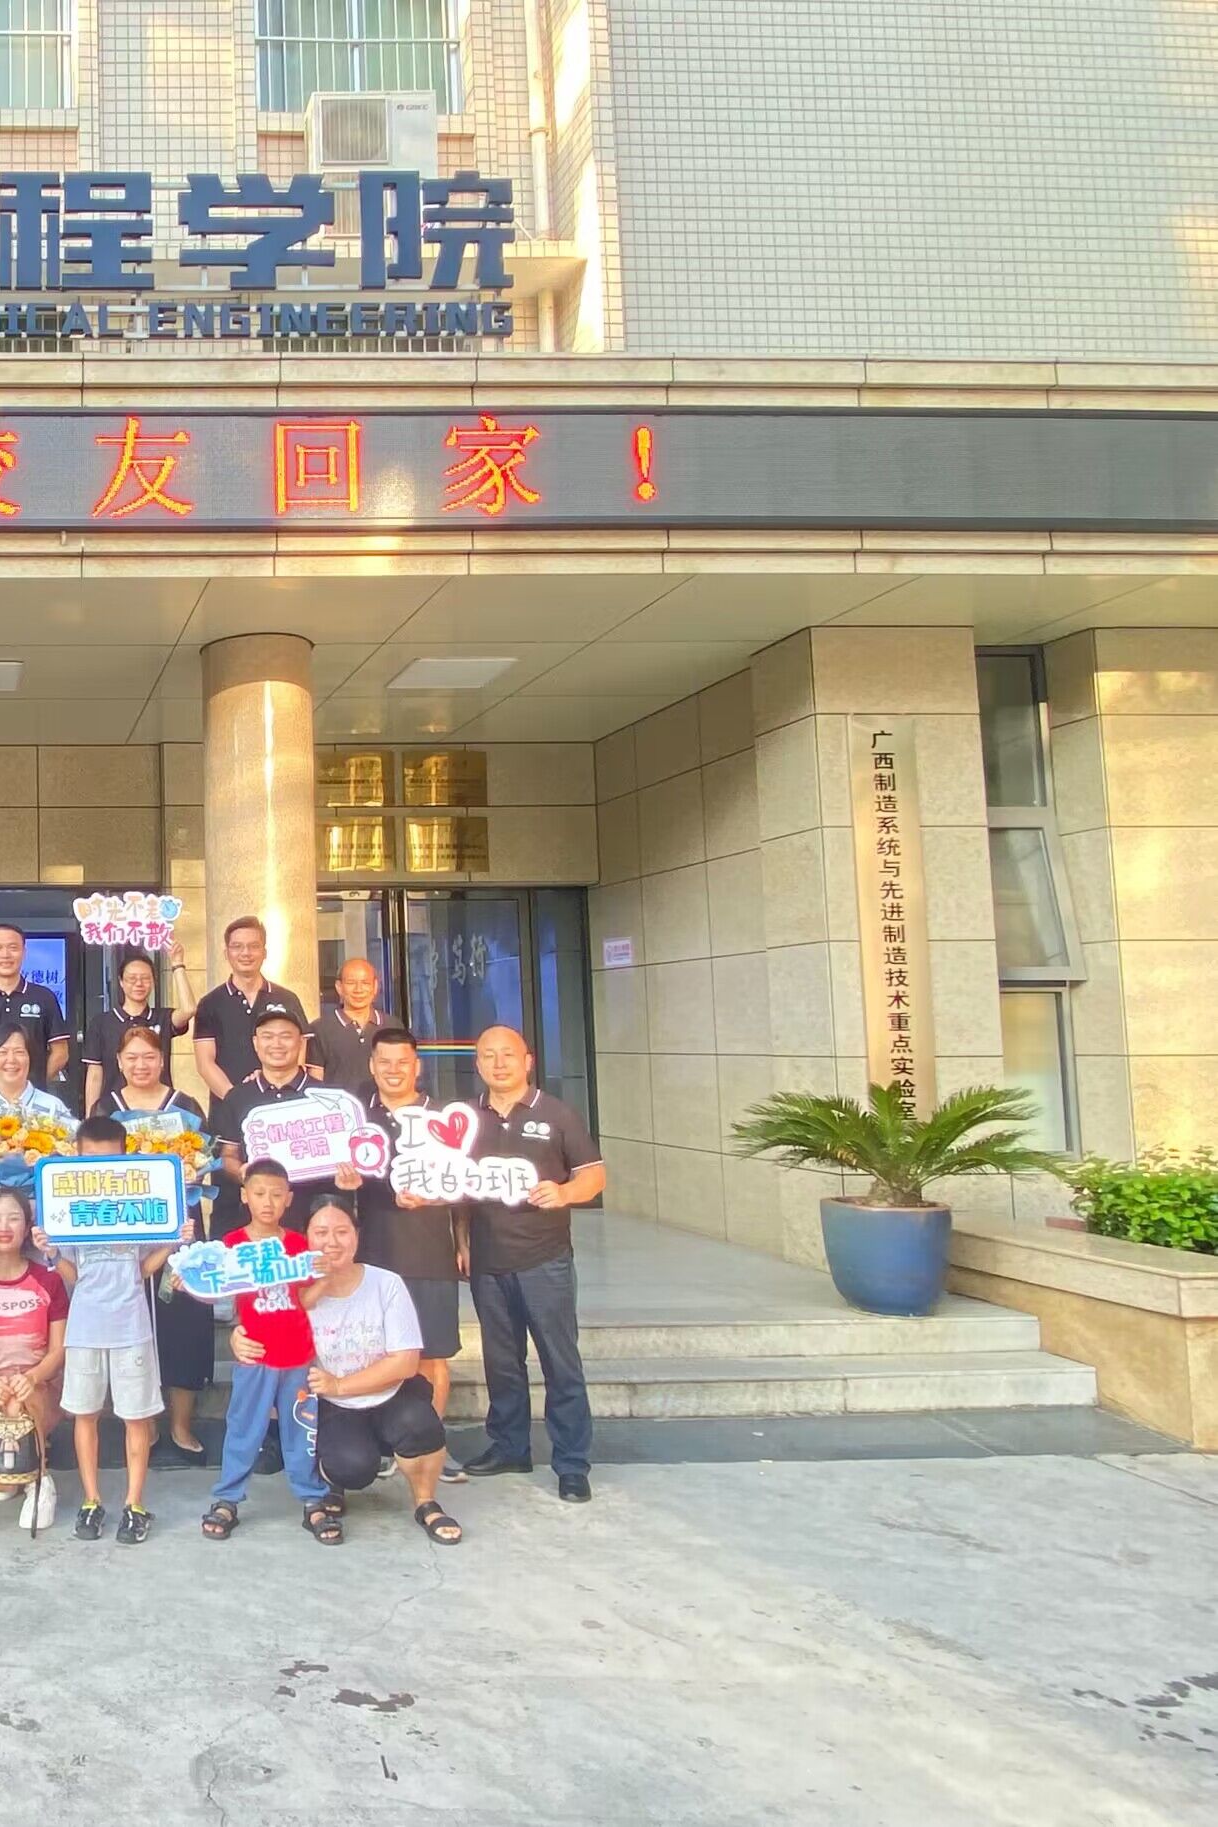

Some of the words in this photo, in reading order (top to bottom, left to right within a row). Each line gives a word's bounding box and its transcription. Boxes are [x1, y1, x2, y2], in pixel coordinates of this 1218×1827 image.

[149, 302, 513, 338] ENGINEERING
[84, 920, 173, 948] 我们不散
[267, 1113, 345, 1143] 机械工程
[289, 1136, 330, 1160] 学院
[52, 1168, 150, 1197] 感谢有你
[397, 1158, 530, 1197] 我的班
